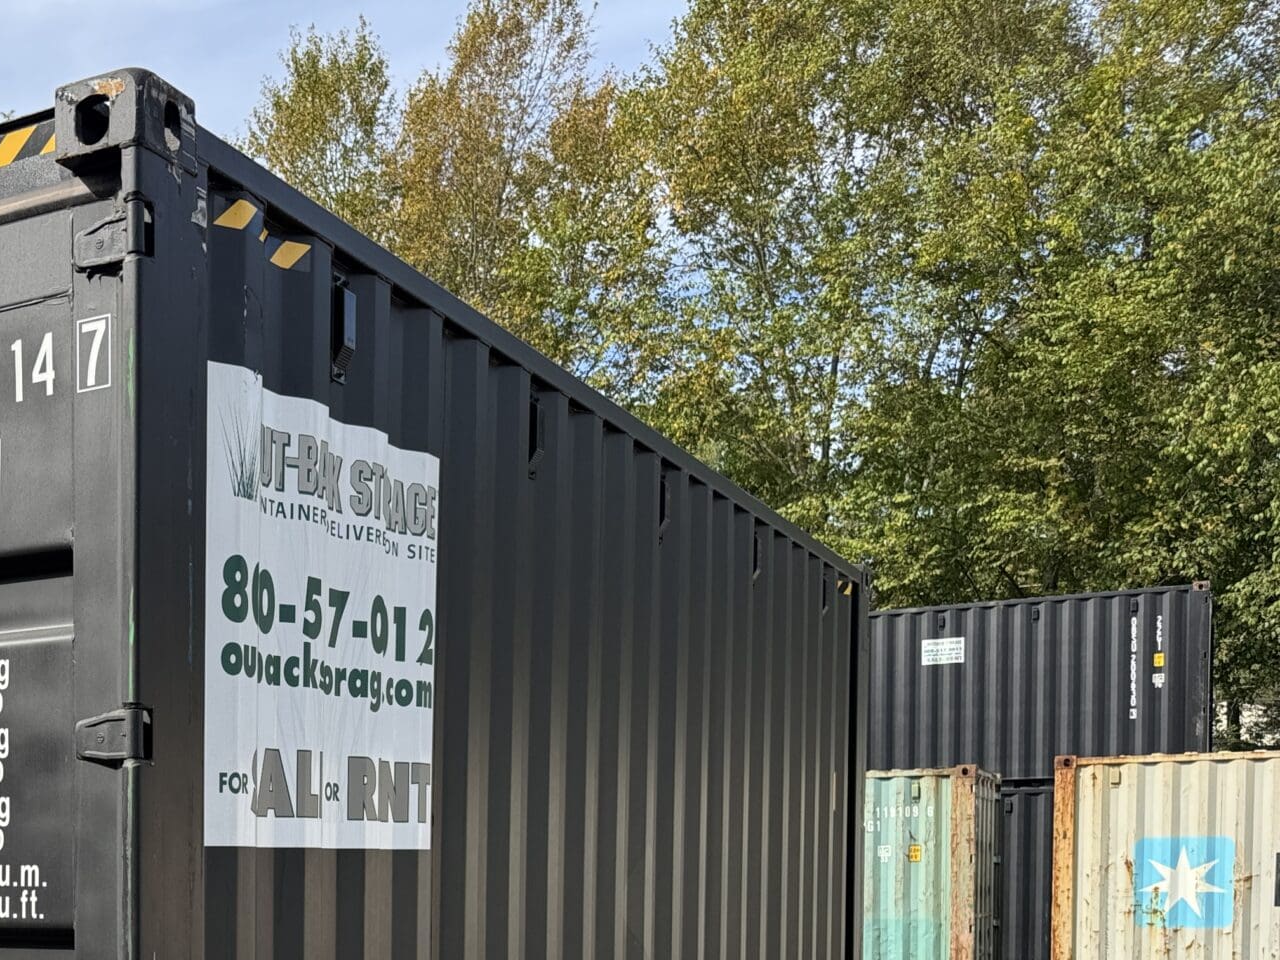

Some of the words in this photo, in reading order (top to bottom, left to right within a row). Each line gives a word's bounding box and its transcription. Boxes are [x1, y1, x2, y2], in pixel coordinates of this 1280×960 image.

[80, 319, 107, 388] 7
[349, 459, 437, 540] STRAGE
[407, 543, 435, 563] SITE
[219, 772, 248, 794] FOR
[251, 747, 323, 818] AL
[324, 782, 340, 802] OR
[347, 755, 431, 823] RNT
